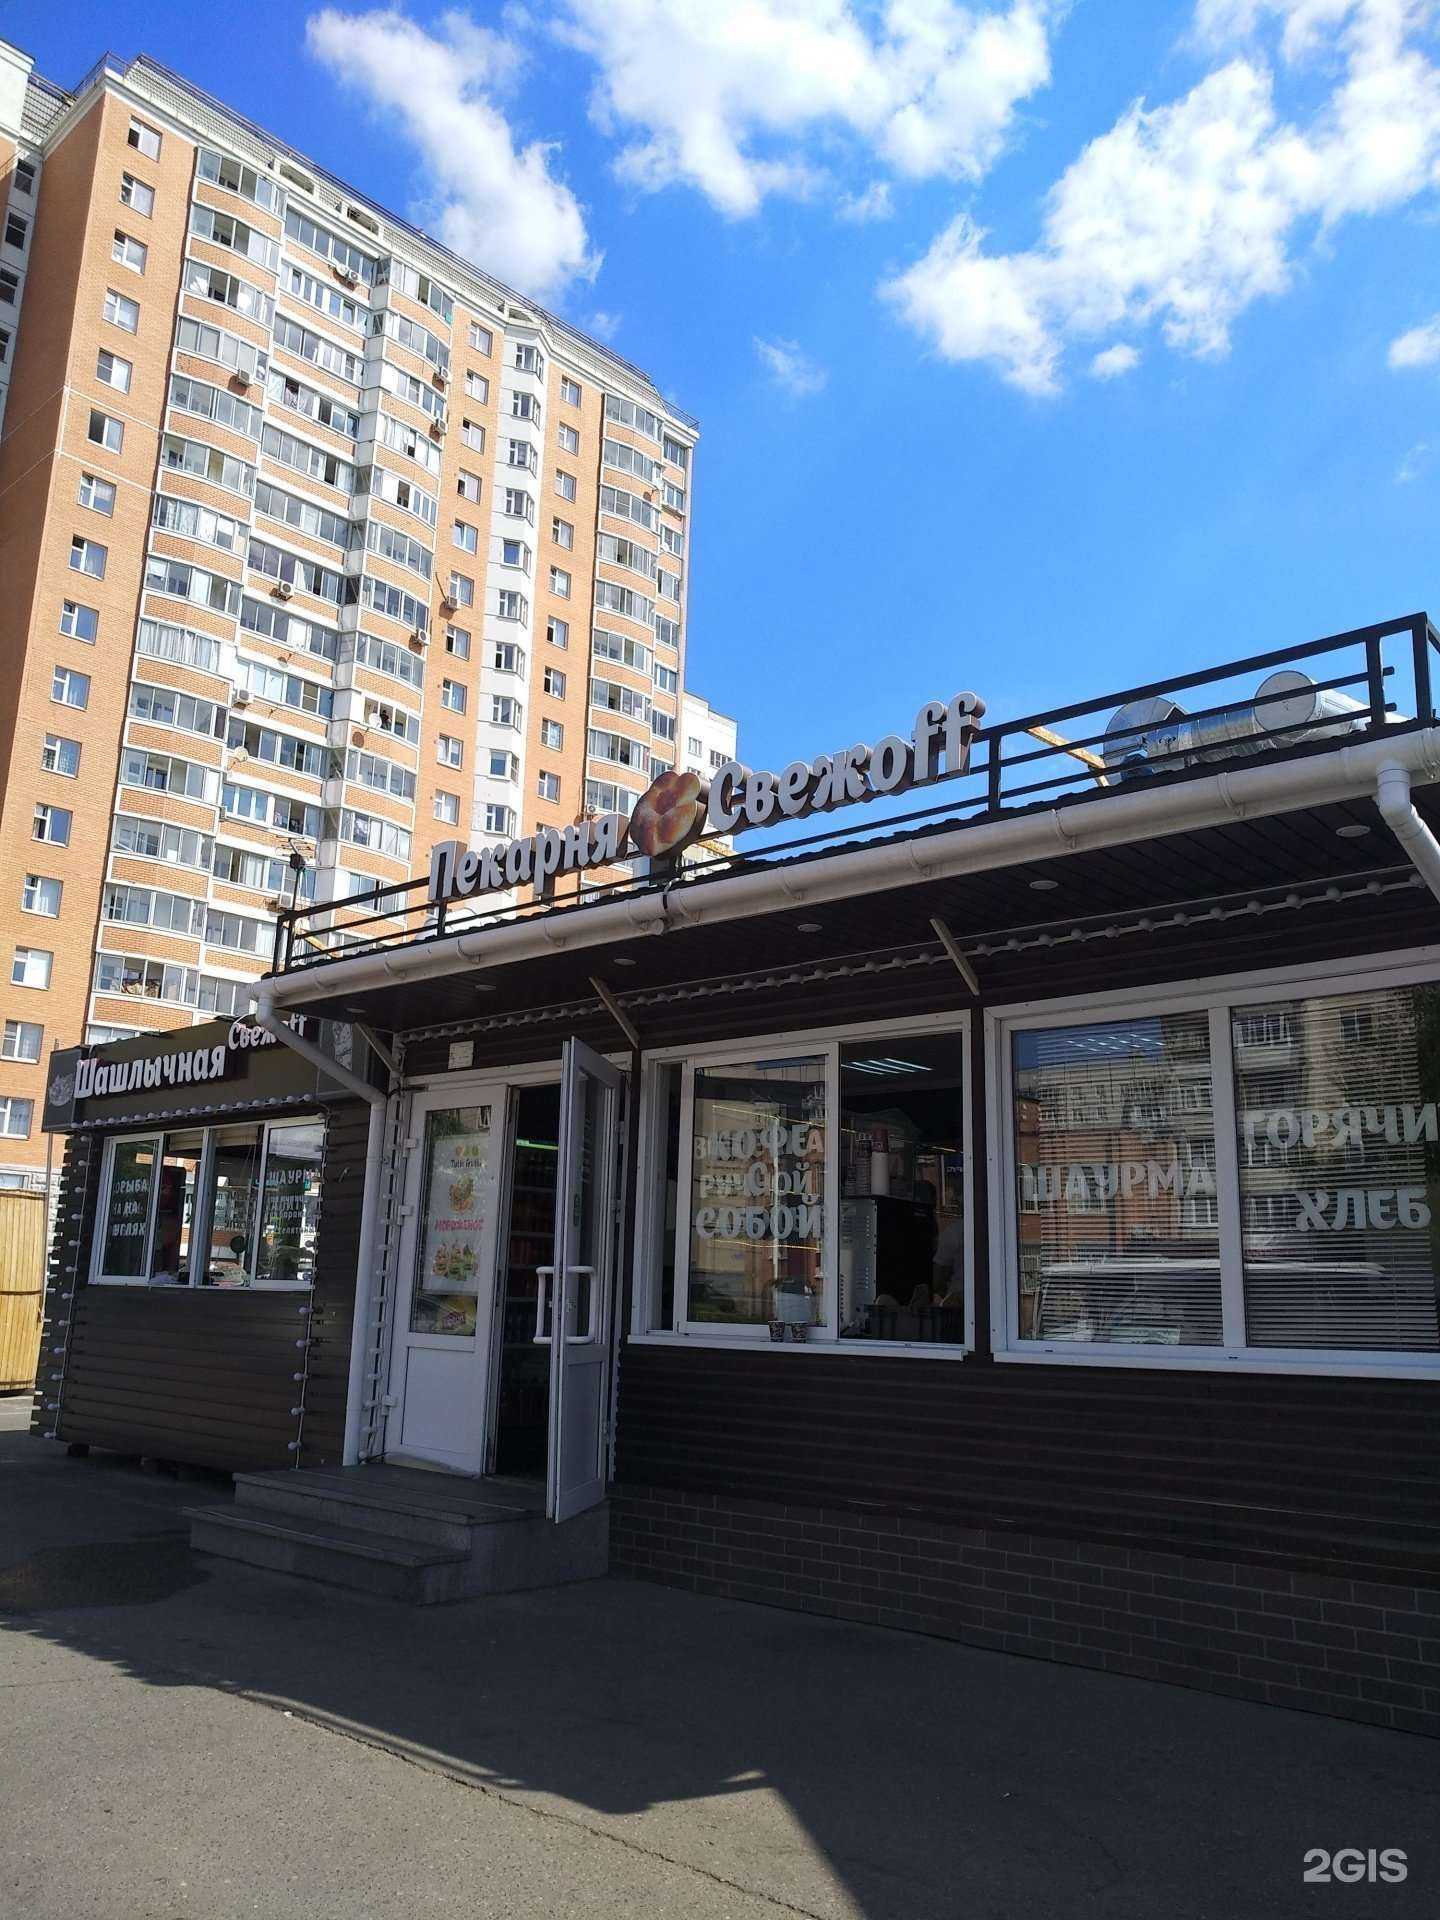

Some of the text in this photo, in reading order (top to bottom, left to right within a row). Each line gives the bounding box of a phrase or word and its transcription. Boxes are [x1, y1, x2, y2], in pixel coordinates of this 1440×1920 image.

[428, 813, 628, 901] Пекарня
[74, 1045, 226, 1099] Шашлычная
[1244, 1103, 1440, 1149] ГОРЯЧИ
[1022, 1160, 1217, 1200] ШАУРМА
[1295, 1187, 1432, 1232] ХЛЕБ
